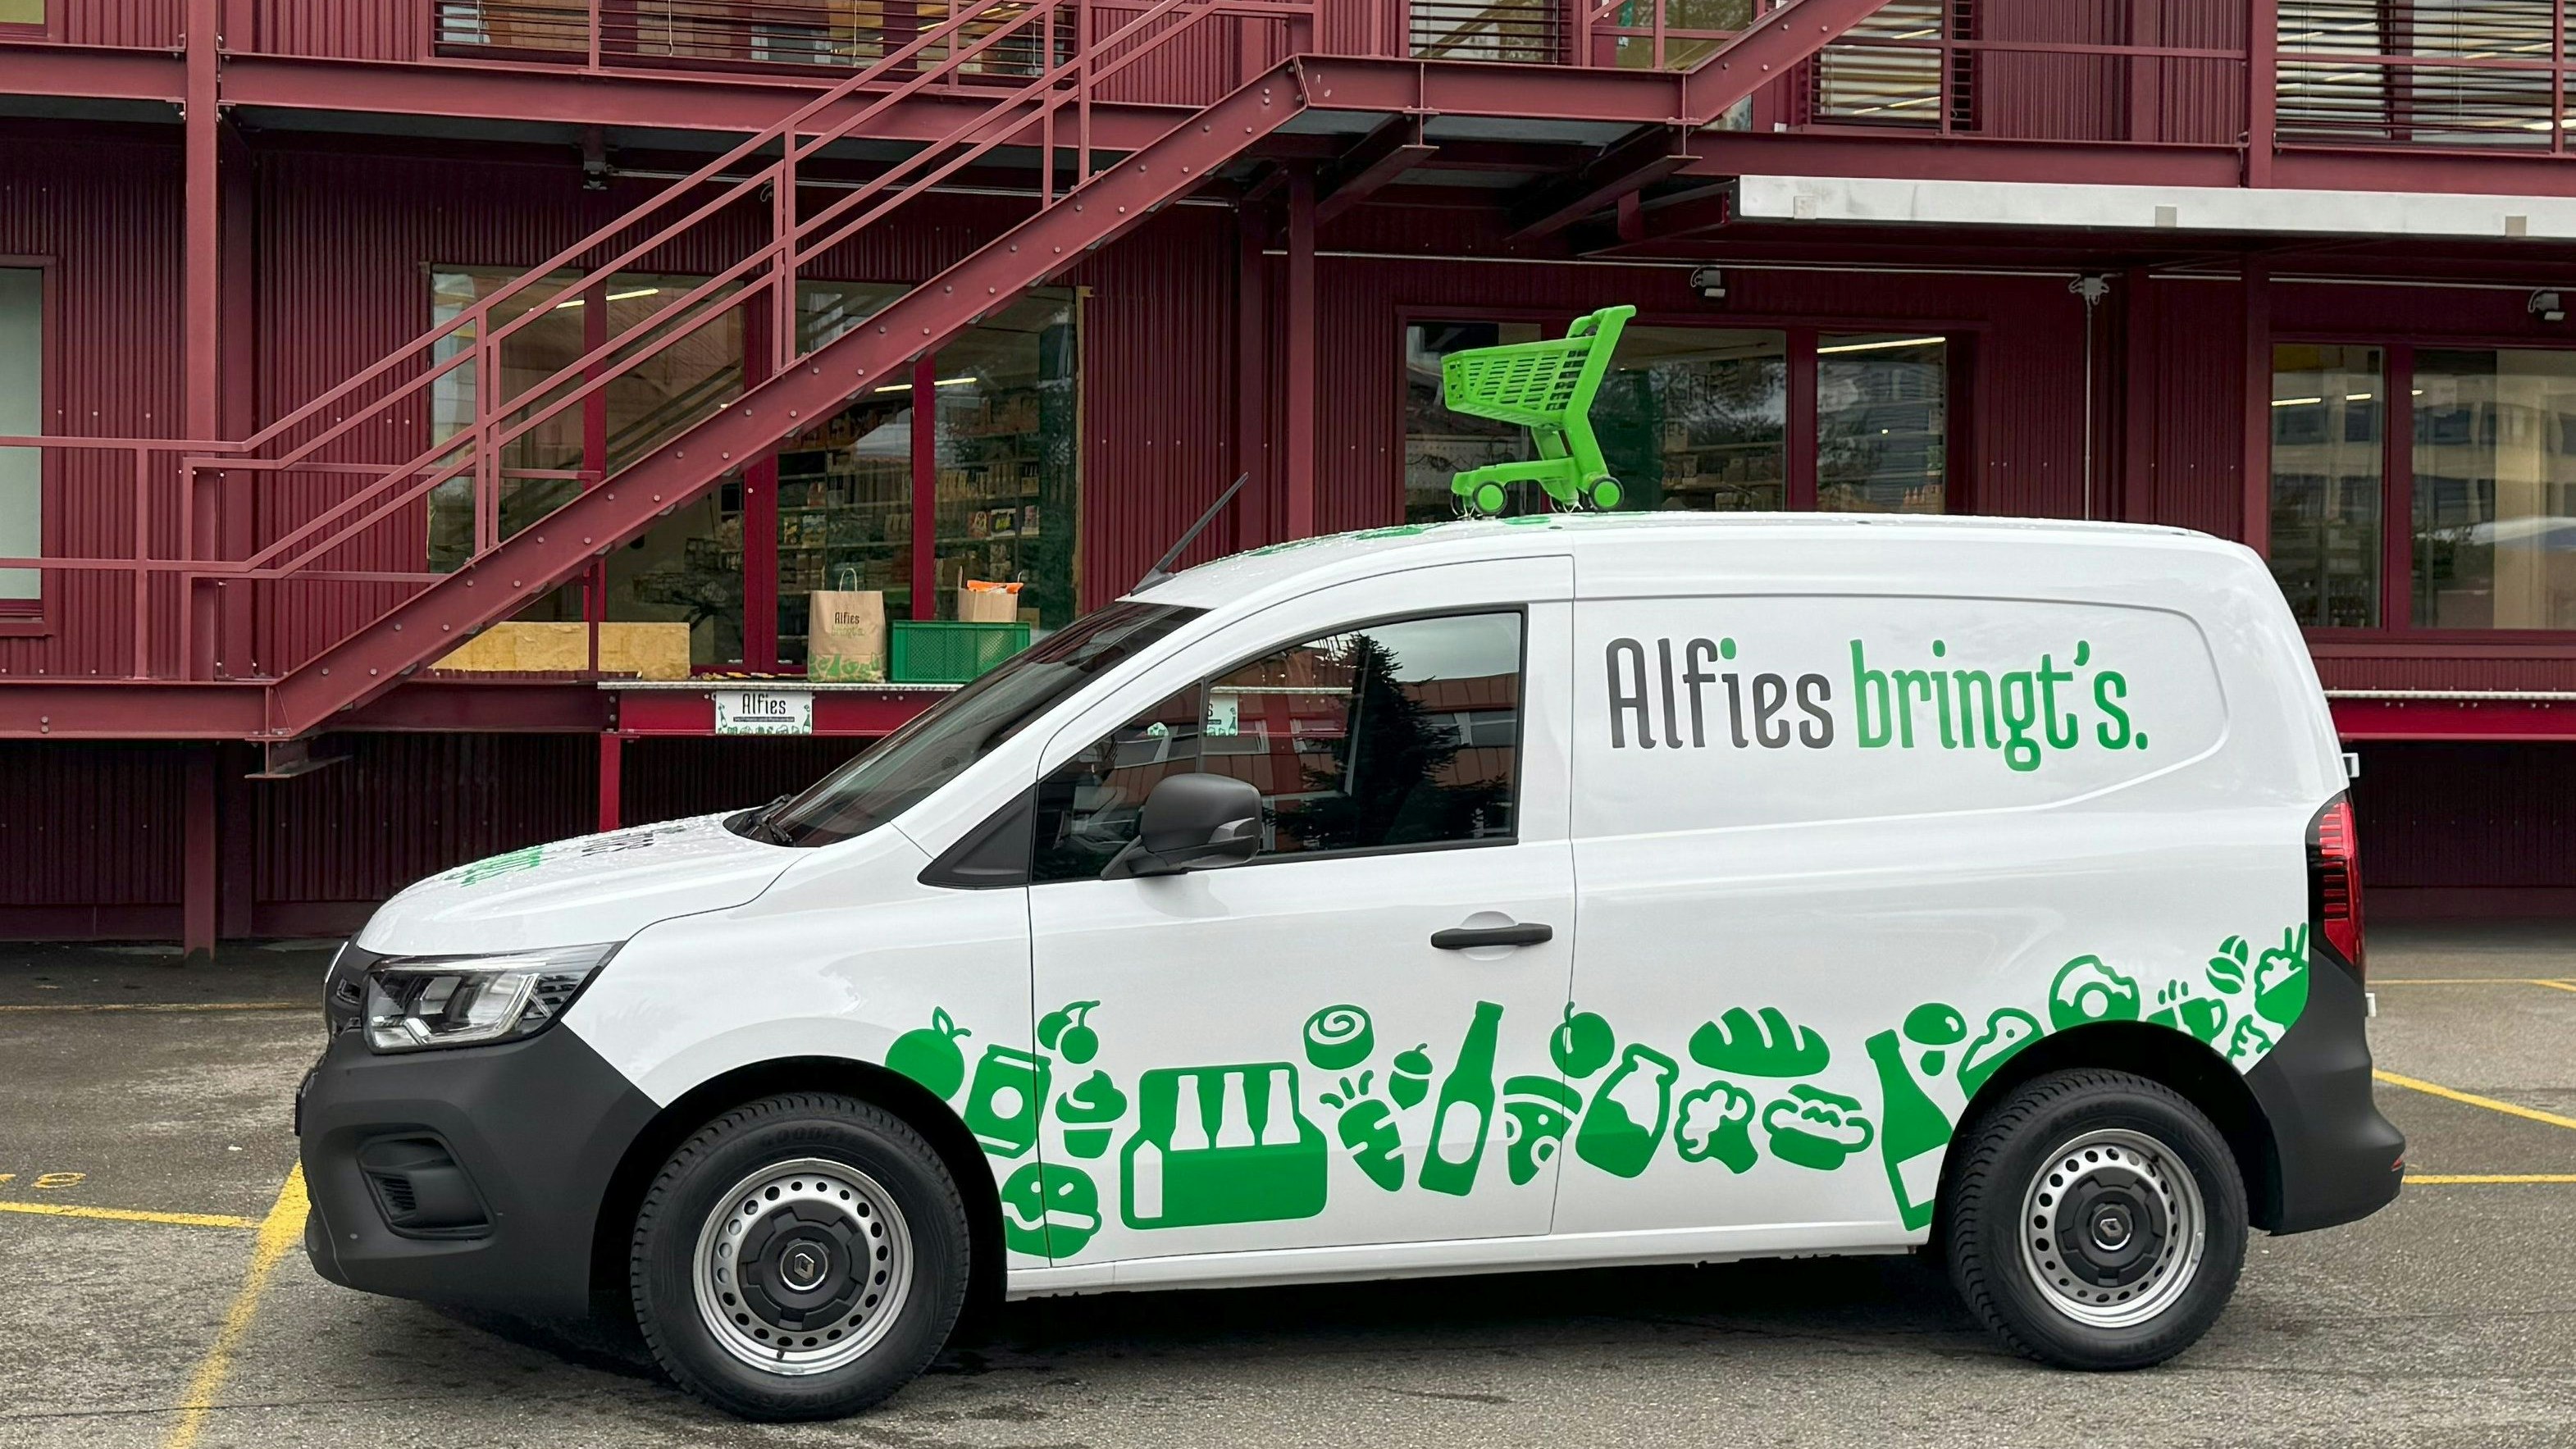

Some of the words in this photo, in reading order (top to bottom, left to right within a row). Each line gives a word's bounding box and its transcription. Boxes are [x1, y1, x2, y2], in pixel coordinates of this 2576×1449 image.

[834, 611, 860, 625] Alfies
[742, 693, 786, 715] Alfies
[1605, 636, 1835, 750] Alfies
[1849, 639, 2148, 772] bringt's.
